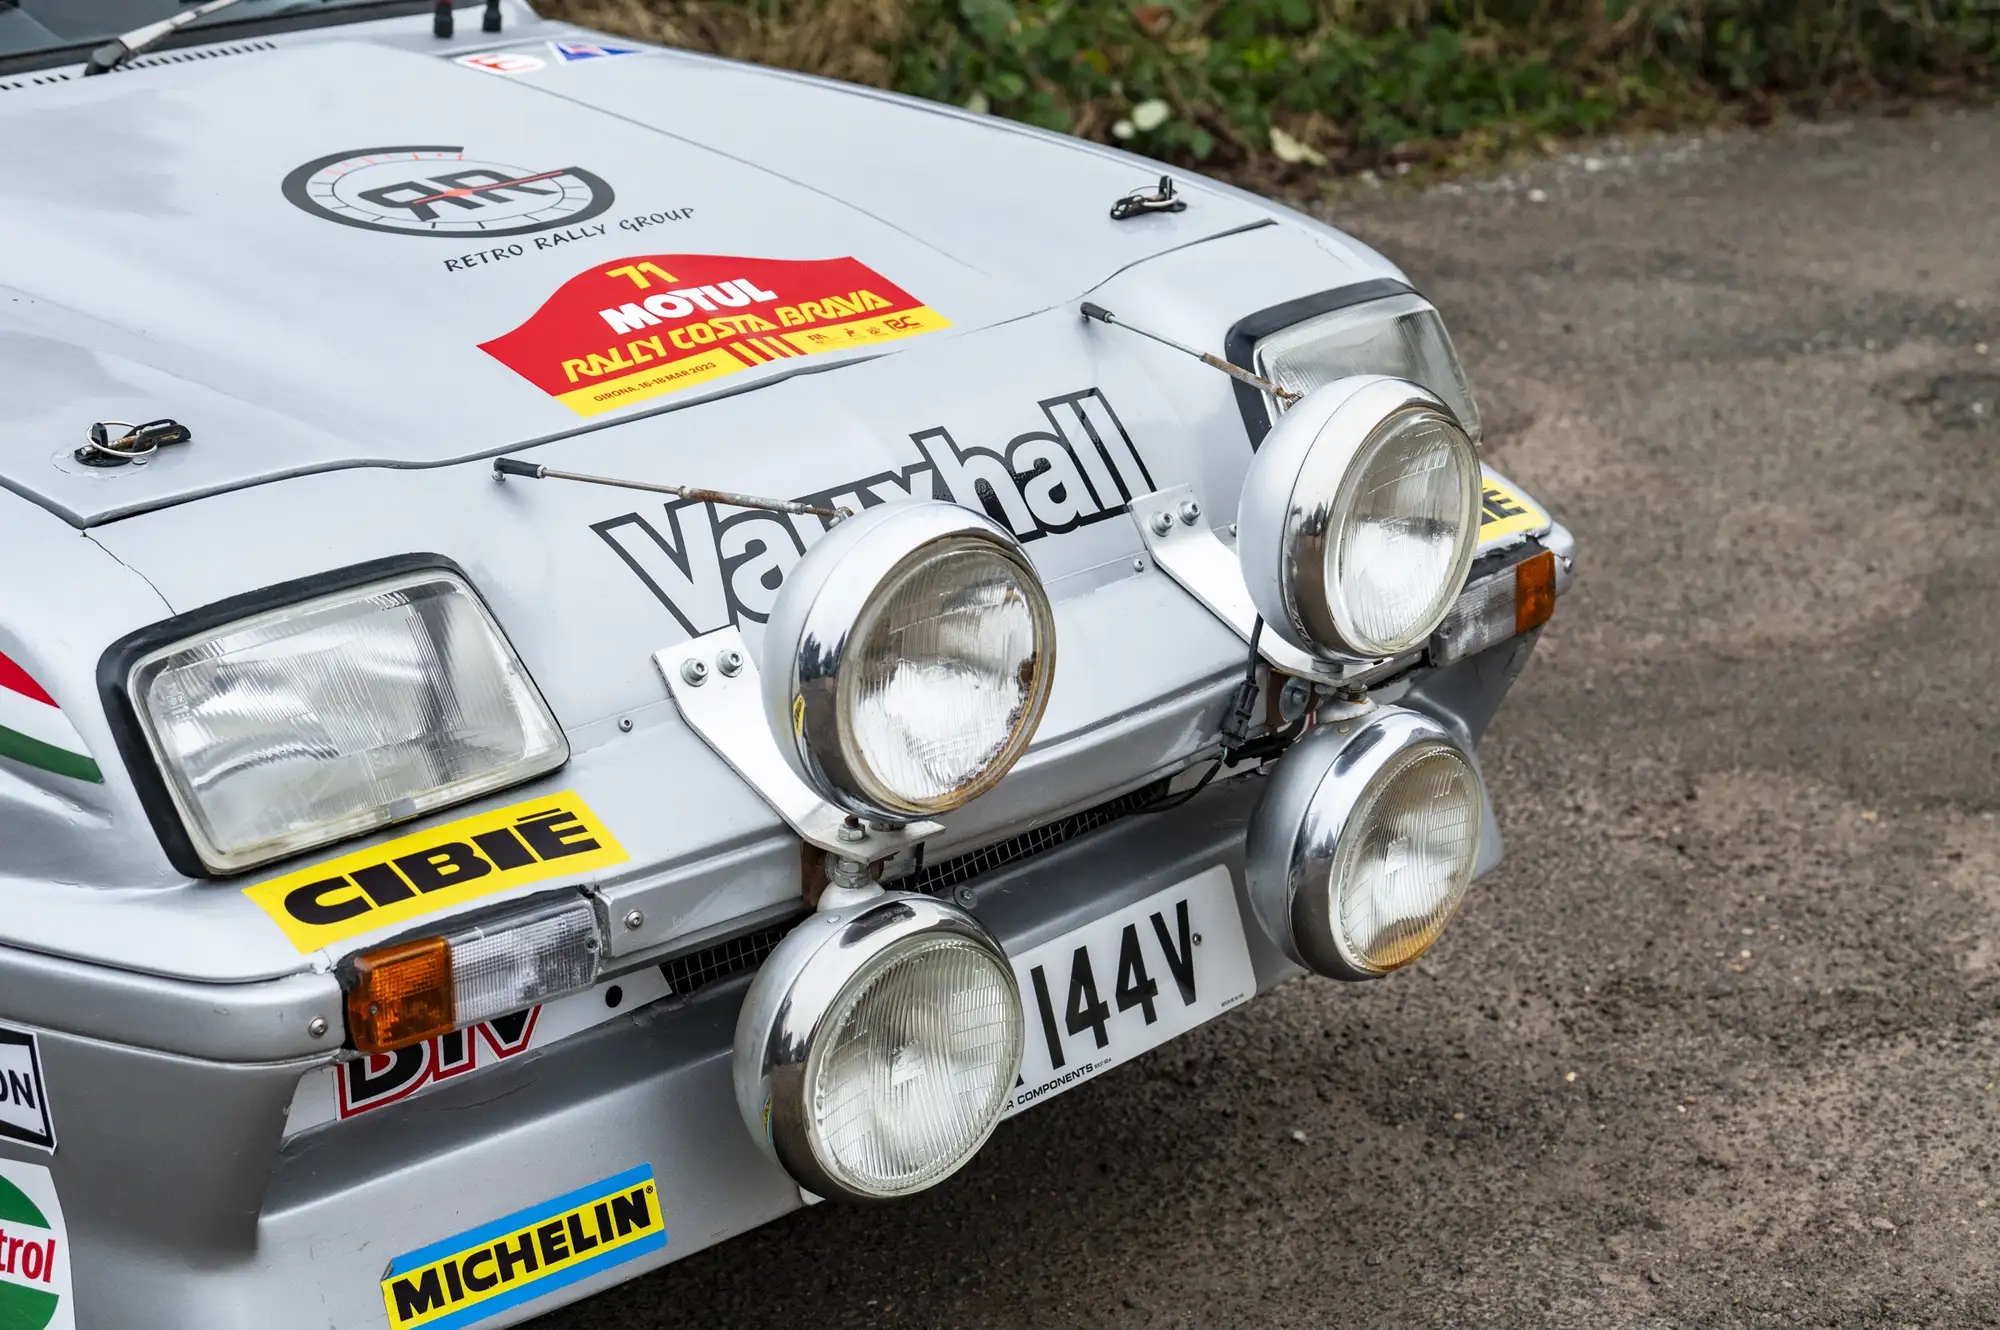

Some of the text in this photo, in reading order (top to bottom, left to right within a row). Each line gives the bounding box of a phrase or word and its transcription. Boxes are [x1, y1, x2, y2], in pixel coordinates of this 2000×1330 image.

[443, 207, 695, 272] RETRO RALLY GROUP
[605, 261, 680, 290] 71
[561, 289, 894, 383] RALLY COSTA BRAVA
[598, 278, 779, 335] MOTUL
[593, 361, 717, 402] GIRONA, 16-18 MAR 2023
[589, 386, 1159, 639] Vahall
[1017, 1062, 1094, 1105] COMPONENTS
[391, 1187, 652, 1323] MICHELIN
